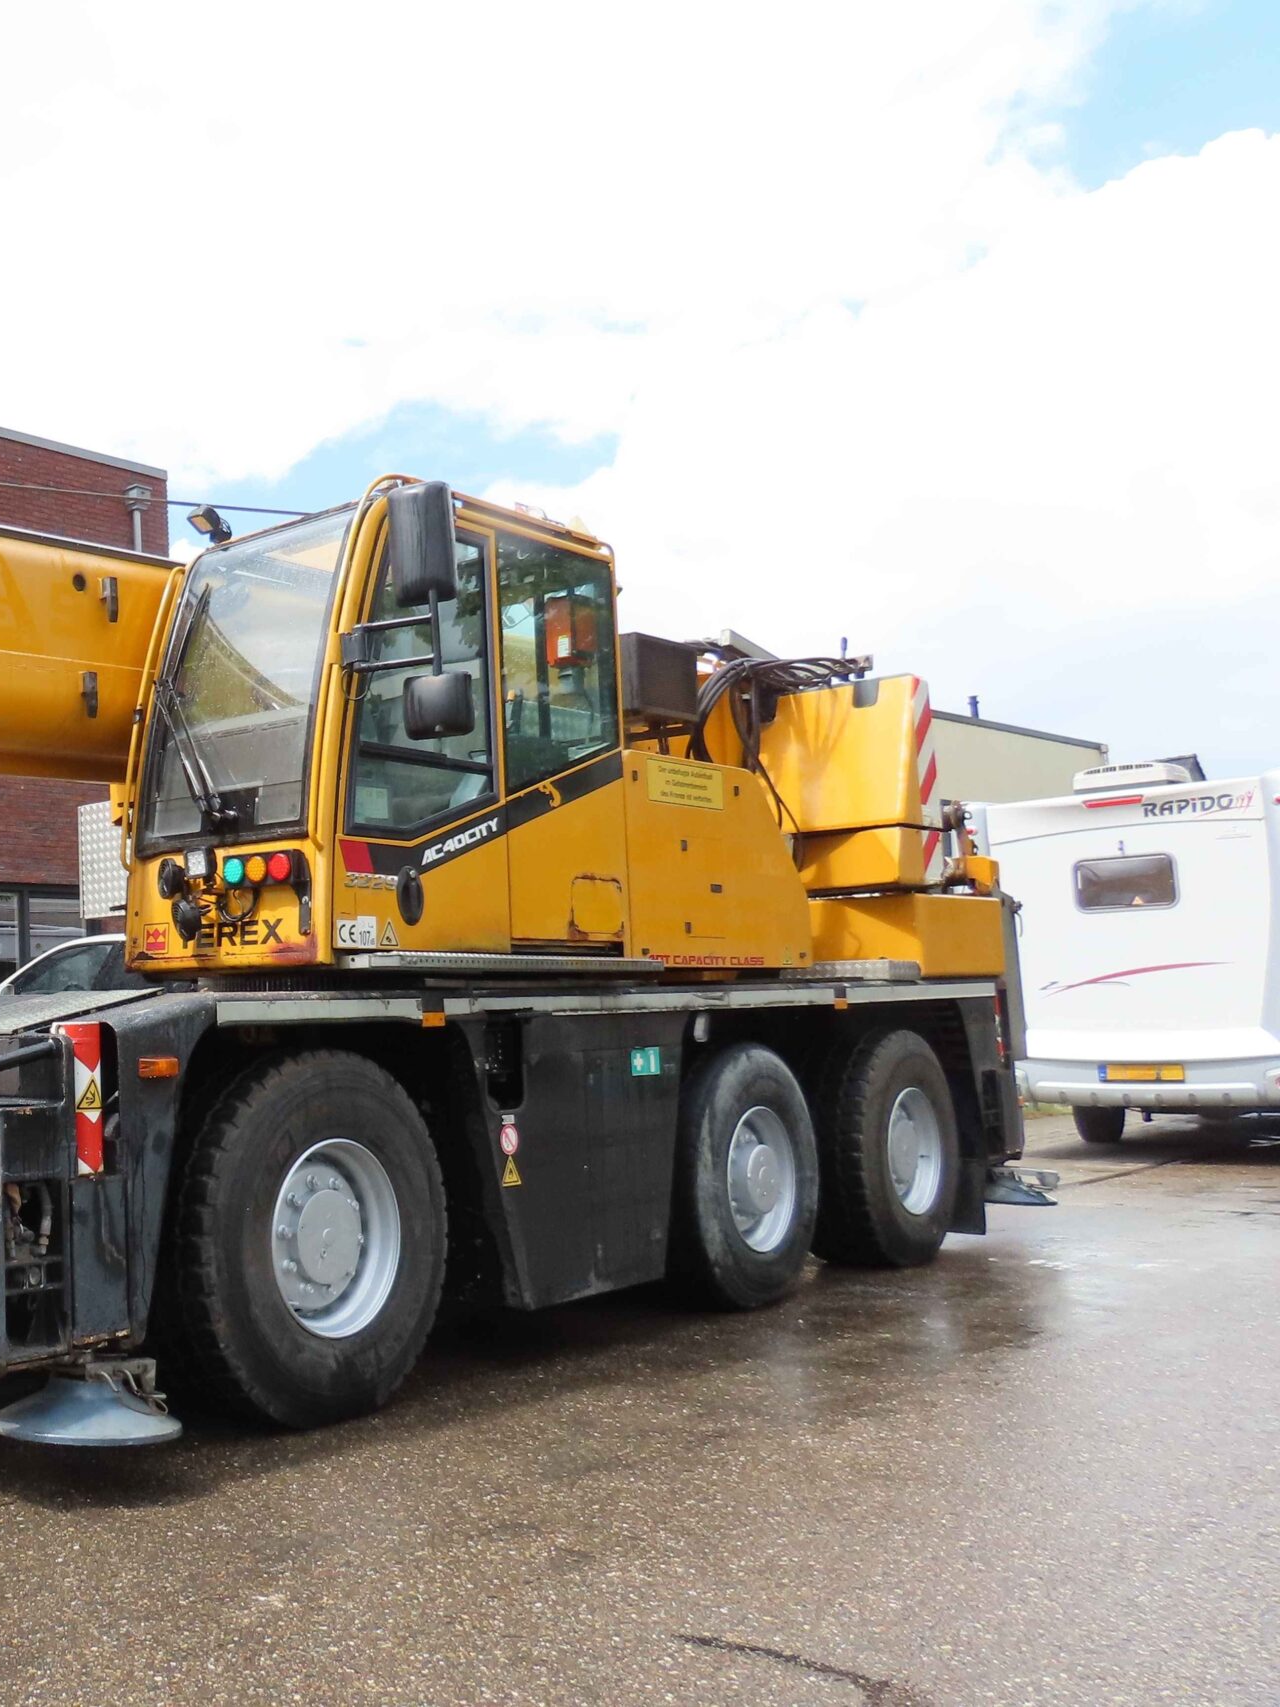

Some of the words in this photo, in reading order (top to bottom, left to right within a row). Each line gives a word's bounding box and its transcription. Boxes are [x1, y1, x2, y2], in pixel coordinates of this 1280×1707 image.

[181, 918, 283, 949] EREX
[338, 924, 356, 943] CE
[673, 955, 727, 966] CAPACITY
[730, 956, 765, 966] CLASS
